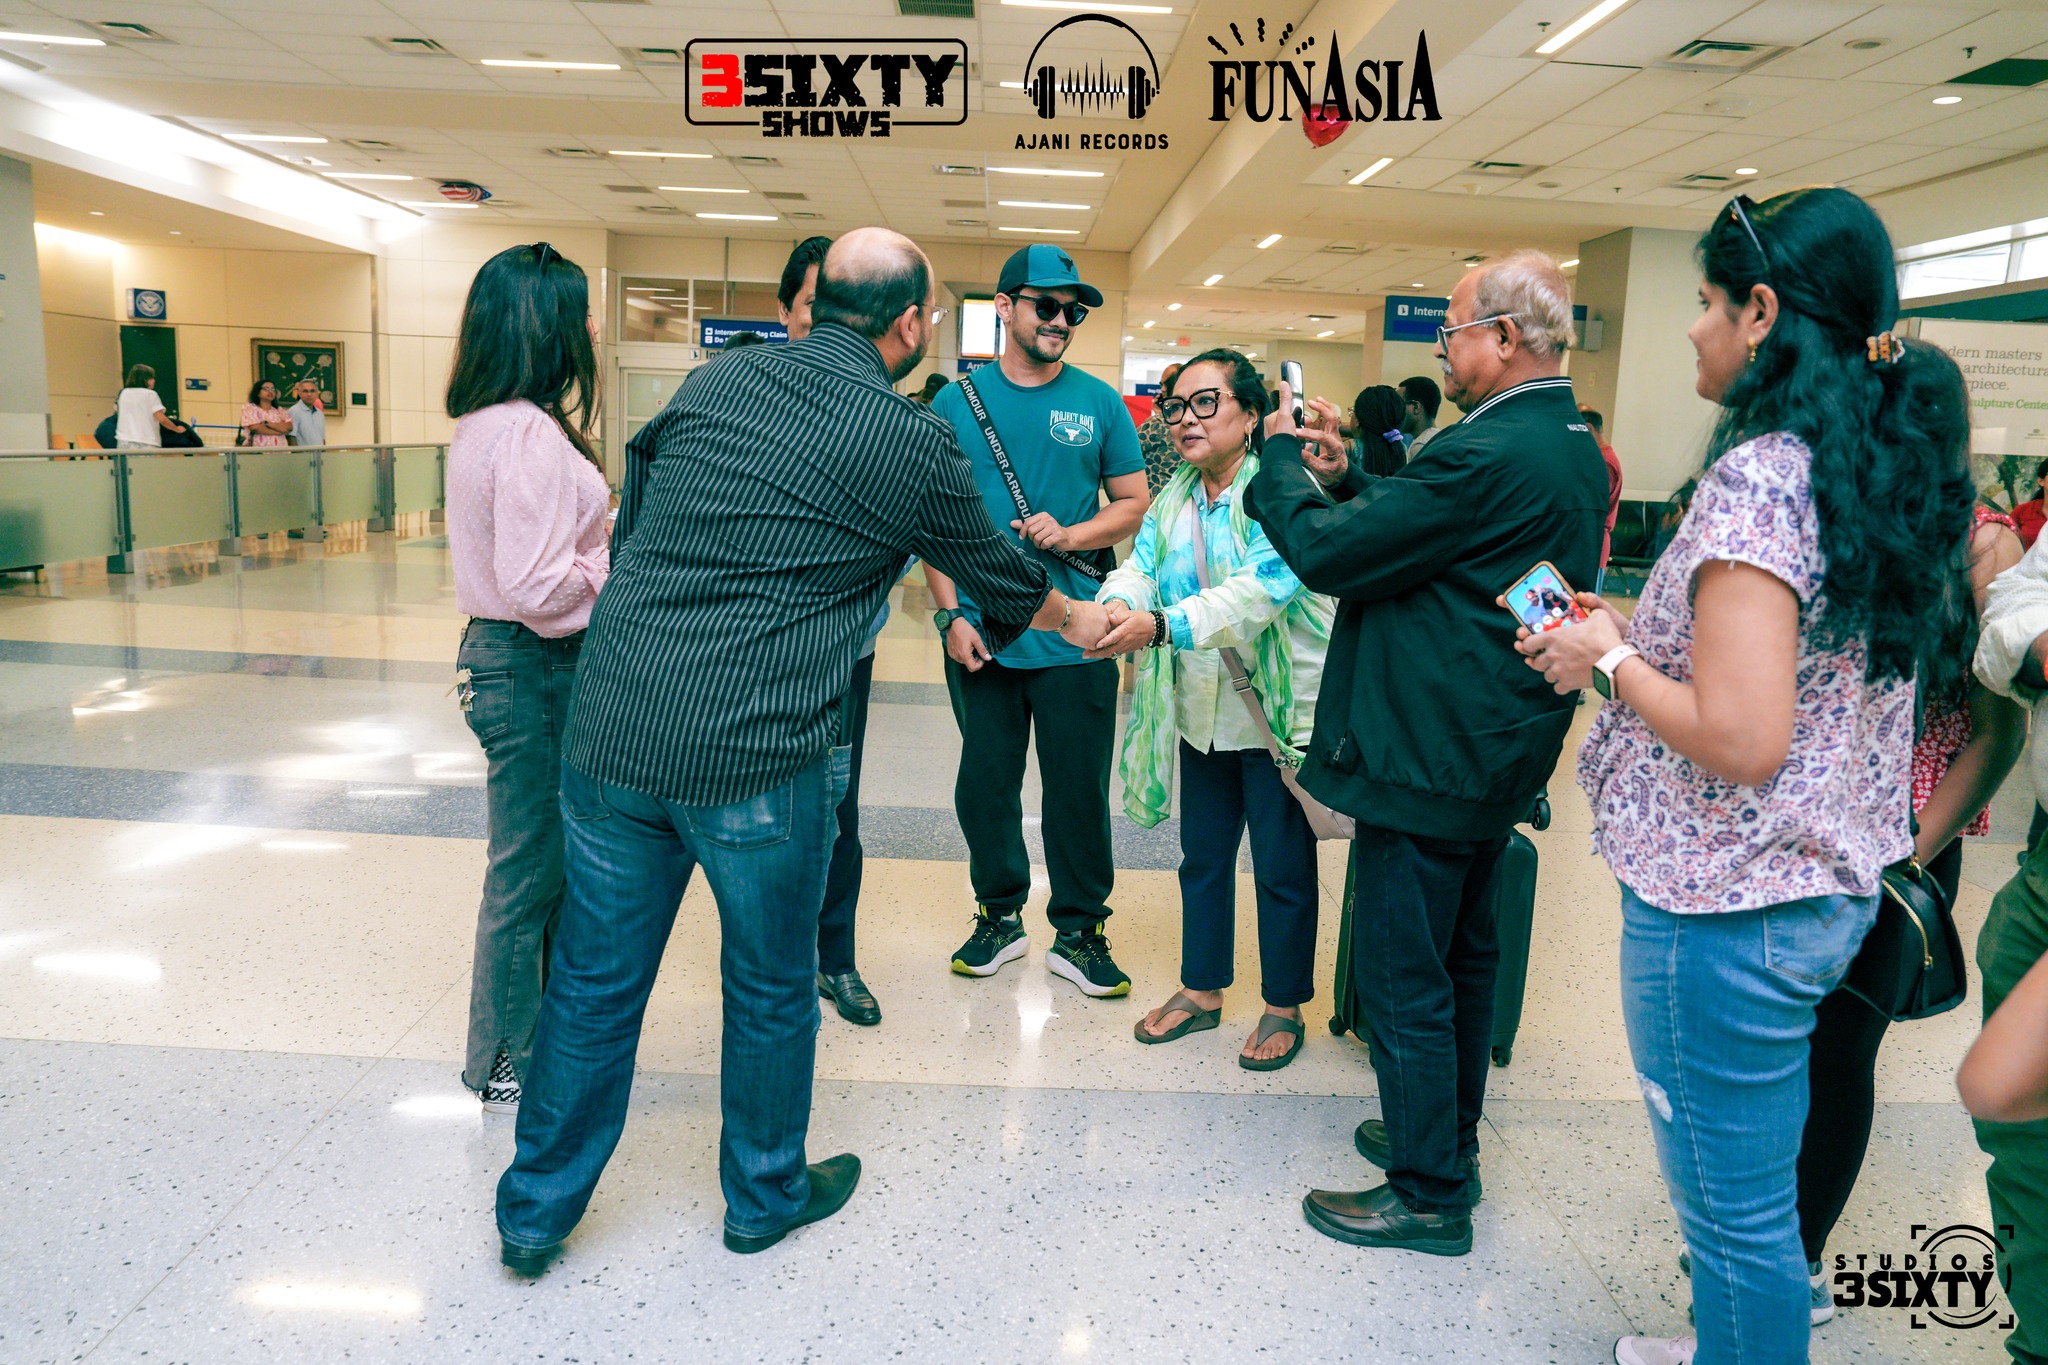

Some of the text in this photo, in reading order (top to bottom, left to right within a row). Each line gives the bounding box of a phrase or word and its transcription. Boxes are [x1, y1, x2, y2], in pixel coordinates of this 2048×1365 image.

[1413, 307, 1447, 316] Intern
[1985, 349, 2042, 360] masters
[1050, 409, 1079, 426] PROJECT
[960, 380, 1031, 520] ARMOUR UNDER ARMOU
